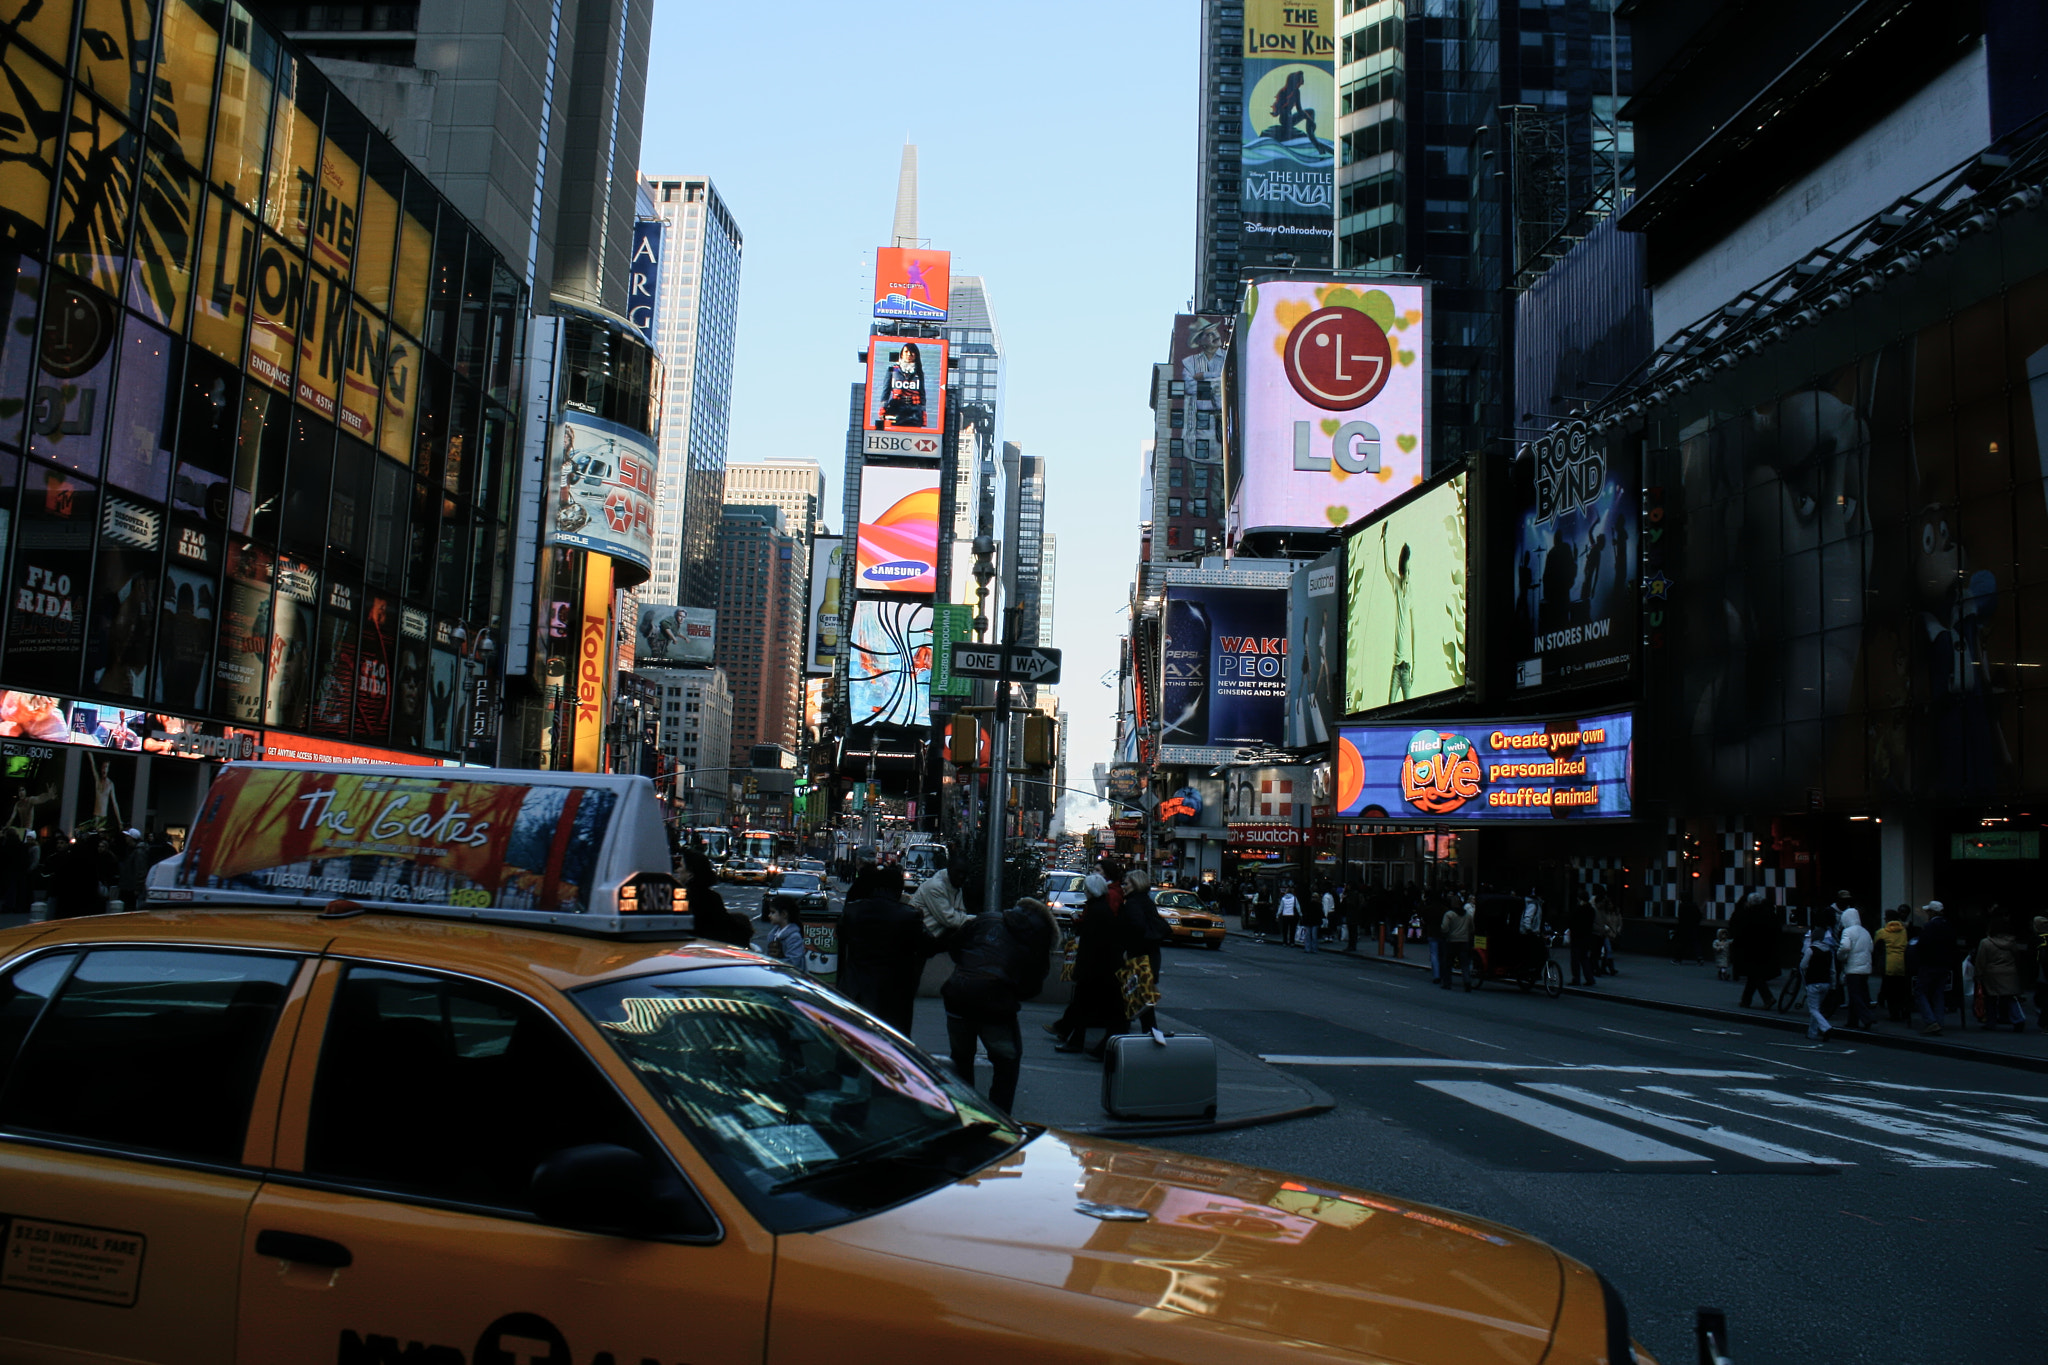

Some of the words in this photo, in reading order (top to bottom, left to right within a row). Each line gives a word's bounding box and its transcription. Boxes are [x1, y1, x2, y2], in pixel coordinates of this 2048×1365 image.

[1283, 9, 1318, 24] THE
[1249, 27, 1296, 53] LION
[1268, 171, 1292, 184] THE
[1295, 172, 1332, 184] LITTLE
[297, 166, 354, 258] THE
[212, 181, 320, 343] LION
[319, 265, 408, 404] KING
[876, 308, 917, 316] PRUDENTIAL
[918, 310, 944, 318] CENTER
[251, 354, 291, 387] ENTRANCE
[300, 385, 313, 400] ON
[315, 391, 334, 412] 45TH
[341, 406, 362, 429] STREET
[891, 378, 920, 390] local
[867, 436, 912, 452] HSBC
[1294, 421, 1381, 474] LG
[1534, 455, 1606, 529] BAND
[114, 510, 144, 528] DISCOVER
[114, 520, 148, 536] DOWNLOAD
[182, 528, 206, 545] FLO
[178, 541, 208, 562] RIDA
[26, 564, 71, 596] FLO
[872, 565, 922, 577] SAMSUNG
[333, 583, 350, 596] FLO
[17, 589, 74, 622] RIDA
[330, 594, 352, 612] RIDA
[437, 630, 451, 644] RID
[440, 622, 452, 634] FLO
[942, 610, 952, 646] просимо
[1534, 636, 1544, 654] IN
[1546, 626, 1582, 652] STORES
[1585, 618, 1610, 639] NOW
[364, 658, 386, 679] FLO
[579, 615, 604, 724] Kodak
[966, 654, 995, 668] ONE
[1017, 657, 1047, 672] WAY
[360, 676, 387, 696] RIDA
[475, 679, 488, 706] ברוך
[1218, 688, 1254, 696] GINSENG
[1238, 680, 1257, 688] DIET
[1258, 680, 1280, 688] PEPSI
[473, 712, 486, 736] הבא
[178, 729, 241, 758] element
[1410, 738, 1442, 752] filled
[1447, 742, 1466, 752] with
[1490, 732, 1548, 750] Create
[1550, 732, 1581, 752] your
[1582, 728, 1605, 744] own
[268, 747, 277, 756] GET
[277, 748, 296, 758] ANYTIME
[296, 750, 312, 761] ACCESS
[312, 752, 318, 762] TO
[319, 754, 332, 763] FUNDS
[1489, 757, 1586, 782] personalized
[1489, 786, 1552, 807] stuffed
[1554, 785, 1598, 806] animal!
[299, 788, 355, 834] The
[371, 795, 490, 848] Gates
[1246, 829, 1299, 844] swatch
[266, 872, 322, 892] TUESDAY,
[324, 878, 389, 897] FEBRUARY
[622, 886, 638, 898] OFF
[450, 888, 492, 908] HBO
[620, 899, 638, 912] DUTY
[672, 900, 690, 912] DUTY
[814, 935, 834, 948] dig!
[15, 1225, 50, 1242] $2.50
[52, 1231, 98, 1250] INITIAL
[104, 1238, 137, 1256] FARE
